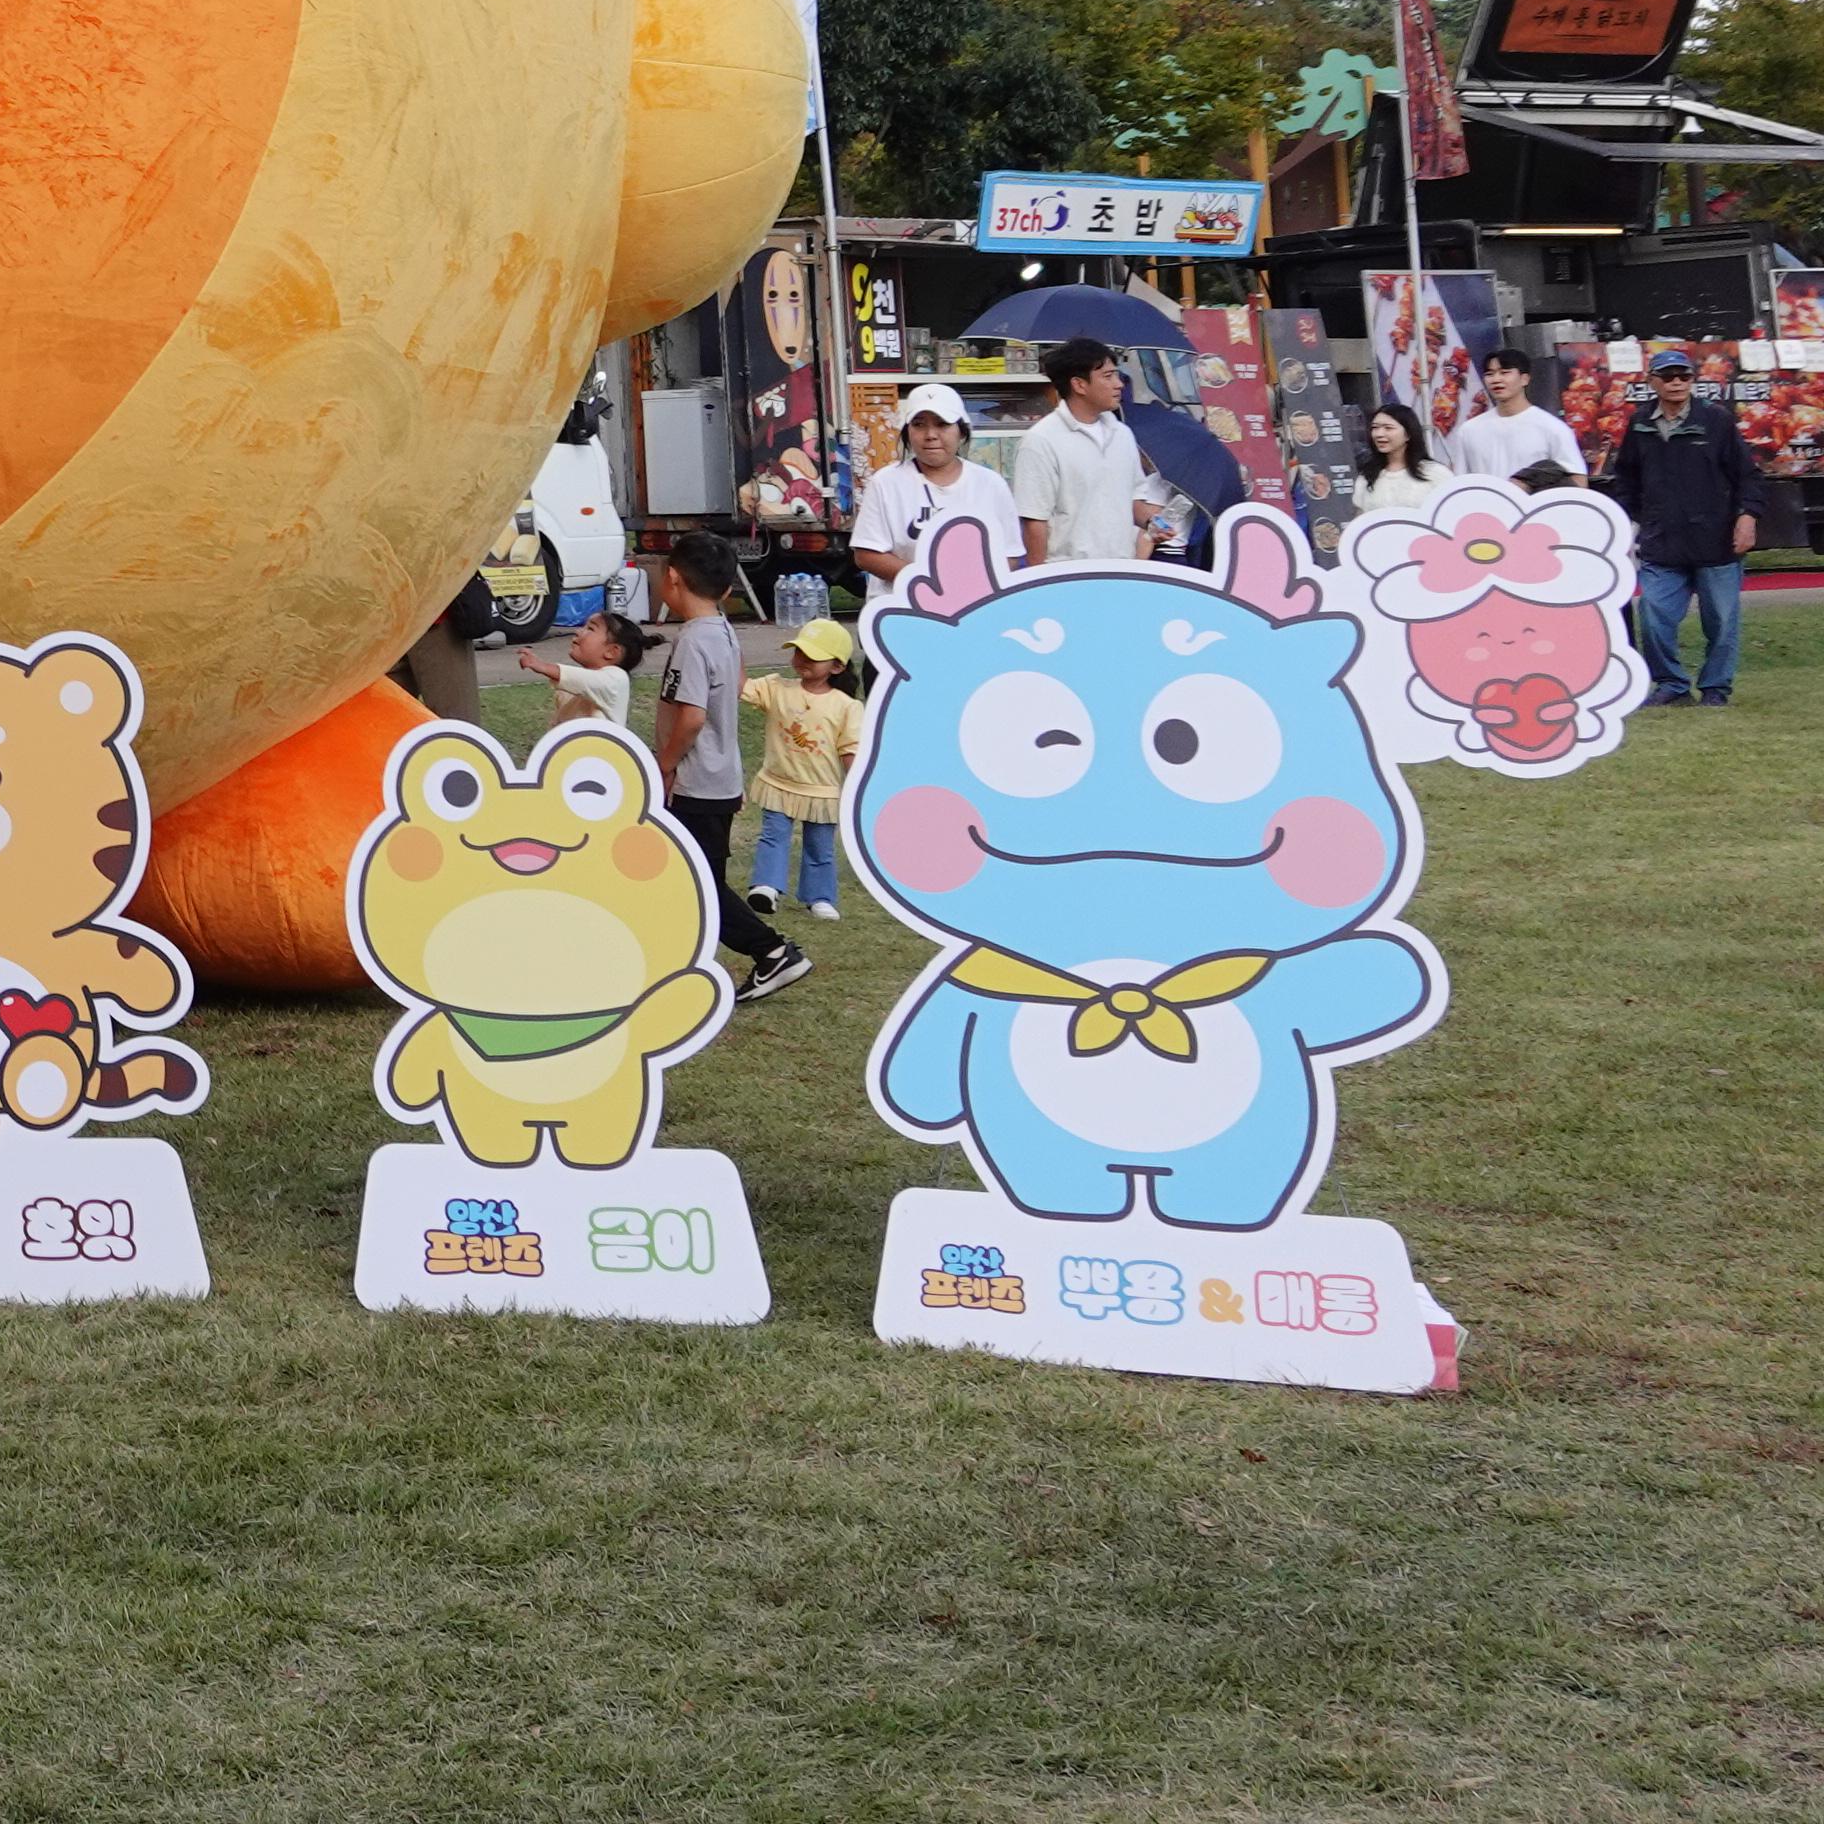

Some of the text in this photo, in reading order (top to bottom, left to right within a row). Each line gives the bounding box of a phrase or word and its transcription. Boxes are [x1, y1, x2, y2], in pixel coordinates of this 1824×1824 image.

[444, 1198, 520, 1237] 양산
[587, 1206, 715, 1275] 금이
[423, 1228, 545, 1278] 프렌즈
[939, 1243, 1005, 1278] 양산
[920, 1268, 1027, 1314] 프렌즈
[1198, 1277, 1245, 1324] &
